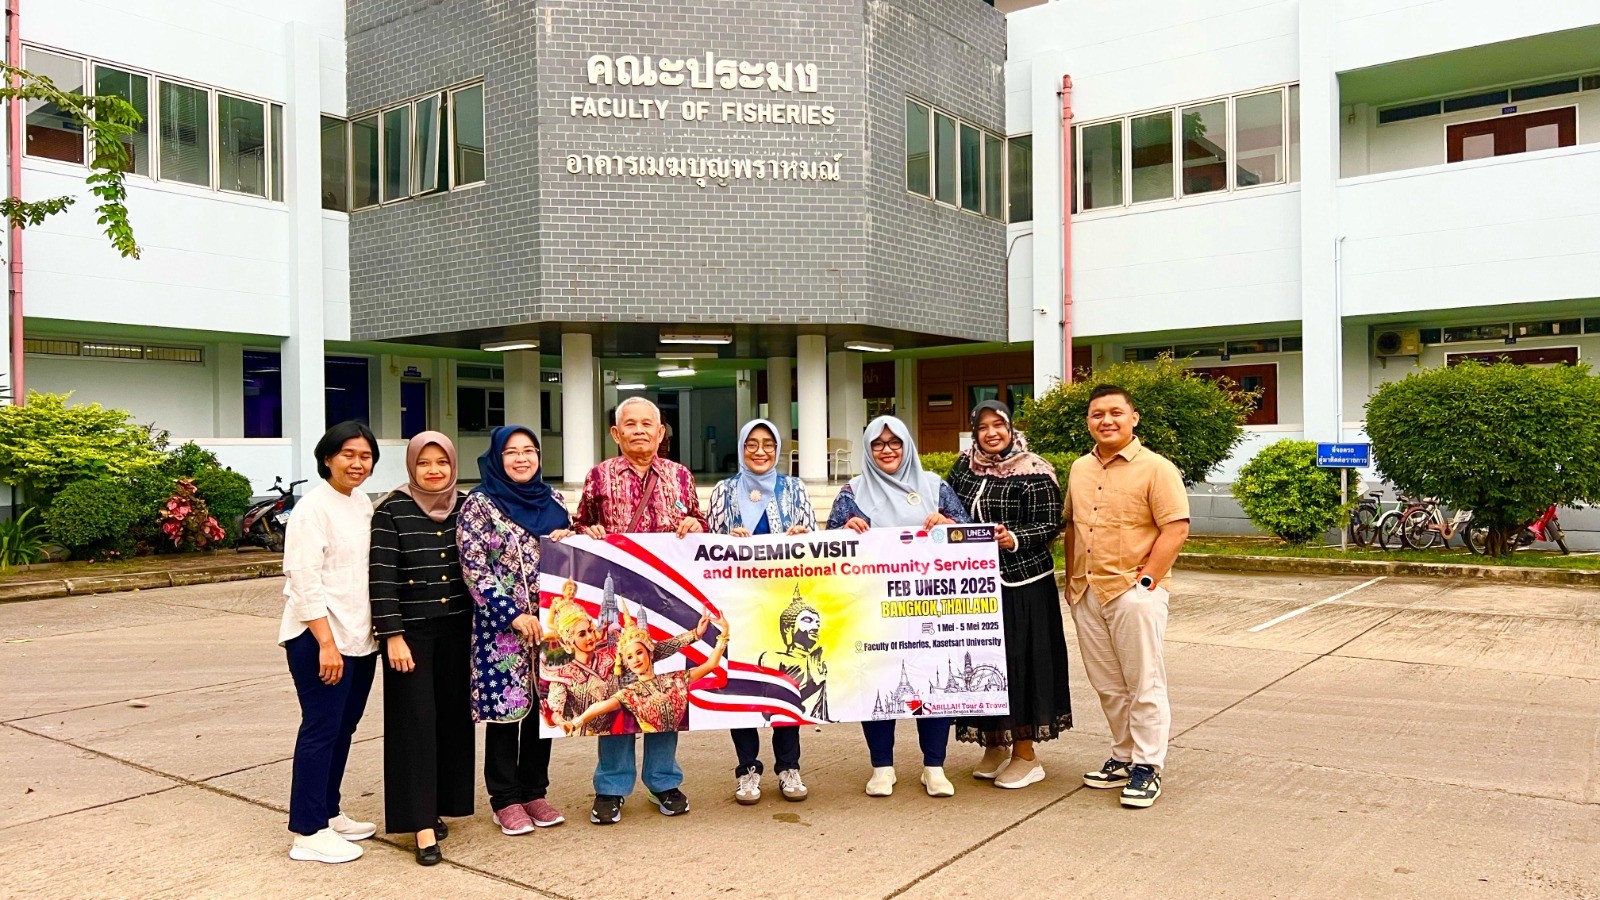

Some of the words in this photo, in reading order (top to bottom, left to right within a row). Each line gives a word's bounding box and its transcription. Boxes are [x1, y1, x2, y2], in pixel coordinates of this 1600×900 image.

[586, 51, 819, 93] คณะประมง
[570, 96, 669, 120] FACULTY
[682, 100, 710, 121] OF
[722, 101, 835, 125] FISHERIES
[966, 529, 991, 537] UNESA
[694, 542, 805, 562] ACADEMIC
[809, 540, 859, 559] VISIT
[703, 564, 732, 579] and
[736, 561, 836, 579] International
[841, 558, 929, 576] Community
[934, 557, 996, 571] Services
[887, 580, 911, 597] FEB
[915, 578, 957, 596] UNESA
[961, 577, 996, 594] 2025
[937, 624, 940, 632] 1
[942, 623, 955, 632] Mei
[960, 623, 965, 631] 5
[967, 622, 980, 631] Mei
[981, 622, 999, 630] 2025
[864, 641, 889, 652] Faculty
[891, 641, 898, 650] Of
[899, 640, 931, 650] Fisheries,
[933, 638, 965, 648] Kasetsart
[966, 637, 1002, 648] University
[923, 702, 960, 715] SABILLAH
